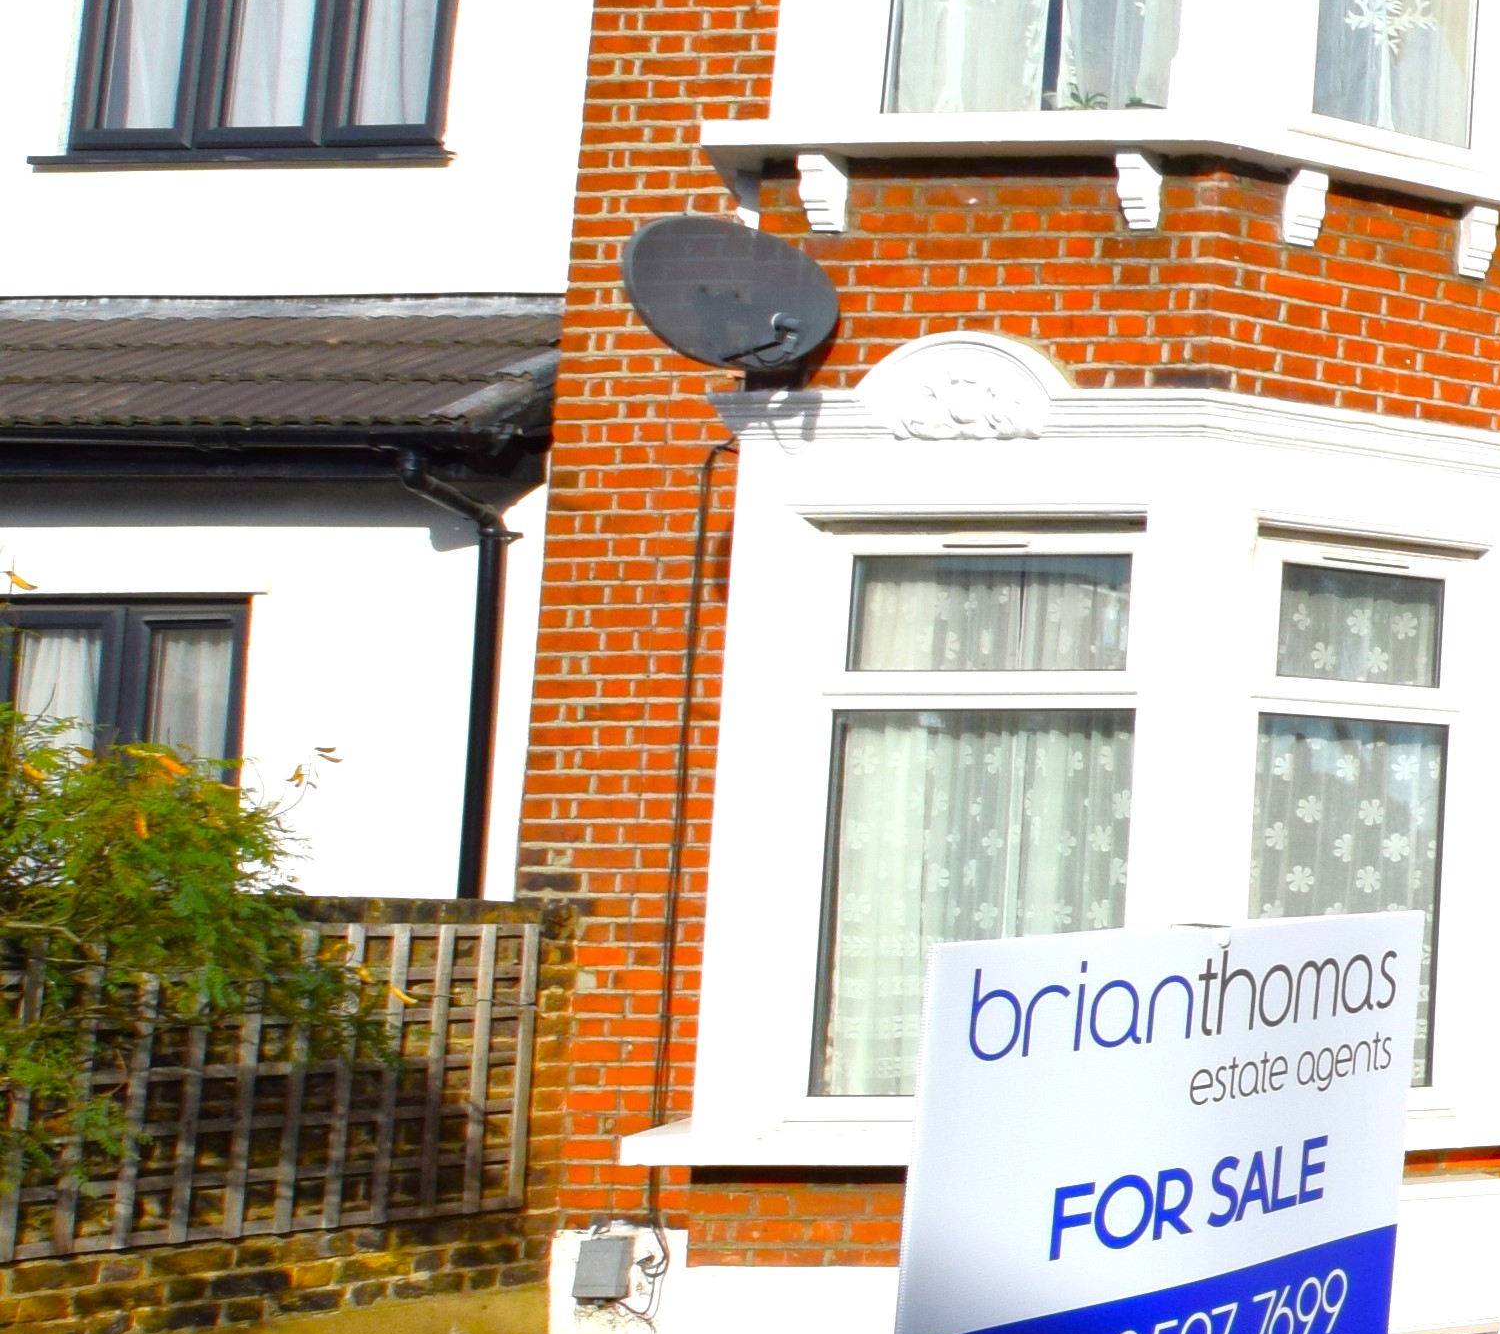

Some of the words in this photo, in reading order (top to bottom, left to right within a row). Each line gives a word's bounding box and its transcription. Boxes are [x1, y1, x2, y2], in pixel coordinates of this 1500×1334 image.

[968, 947, 1398, 1063] brianthomas
[1189, 1049, 1289, 1106] estate
[1295, 1032, 1393, 1093] agents
[1048, 1166, 1194, 1262] FOR
[1206, 1134, 1329, 1228] SALE
